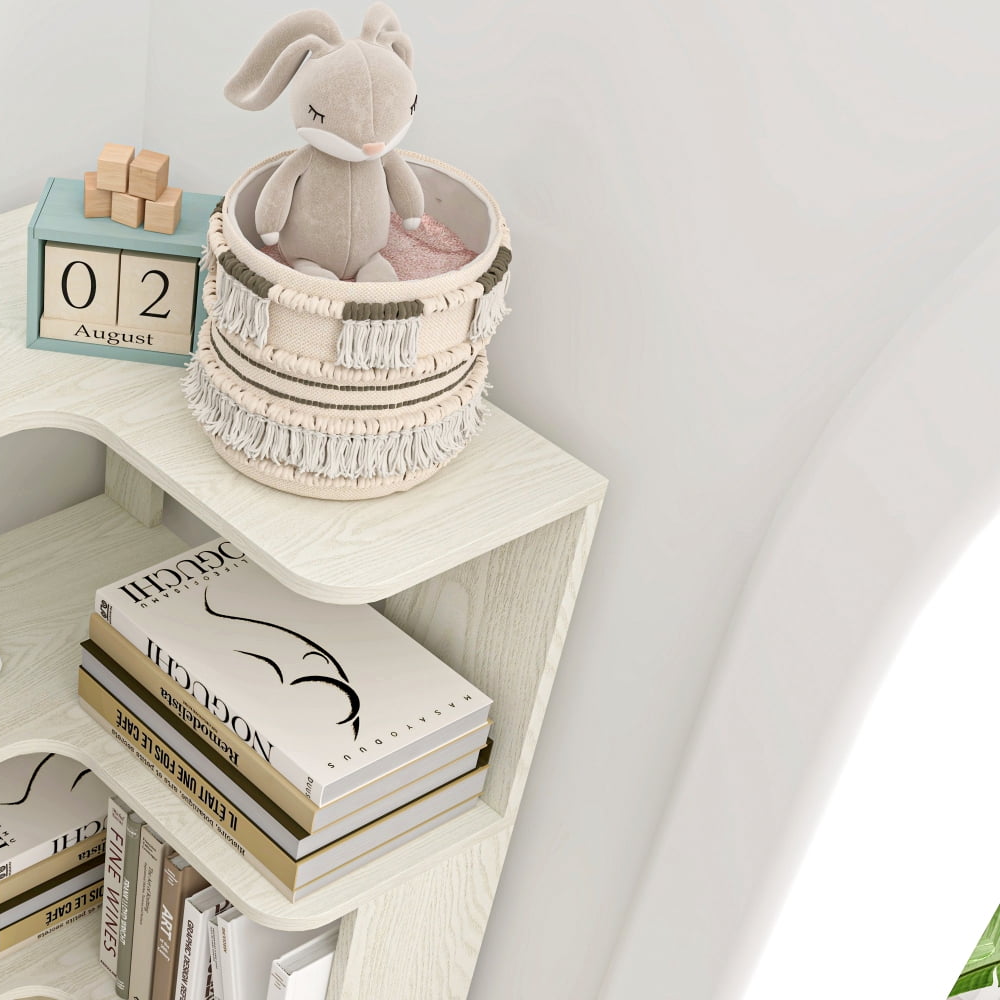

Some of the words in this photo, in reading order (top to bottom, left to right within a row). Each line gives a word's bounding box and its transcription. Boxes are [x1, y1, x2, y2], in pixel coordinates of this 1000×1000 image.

[61, 261, 96, 309] 0
[140, 270, 170, 319] 2
[74, 324, 154, 346] August
[147, 637, 276, 763] NOGUCHI
[390, 694, 472, 737] MASAYO
[116, 709, 139, 741] CAFÉ
[160, 687, 240, 766] Remodelista
[141, 732, 153, 753] LE
[327, 738, 383, 769] DUUS
[155, 745, 176, 774] FOIS
[177, 765, 197, 794] UNE
[198, 786, 226, 821] ÉTAIT
[228, 810, 238, 831] IL
[108, 828, 124, 883] FINE
[46, 904, 72, 927] CAFÉ
[75, 897, 86, 907] LE
[104, 887, 120, 957] WINES
[161, 904, 173, 941] ART
[185, 920, 194, 956] GRAPHIC
[181, 955, 191, 985] DESIGN
